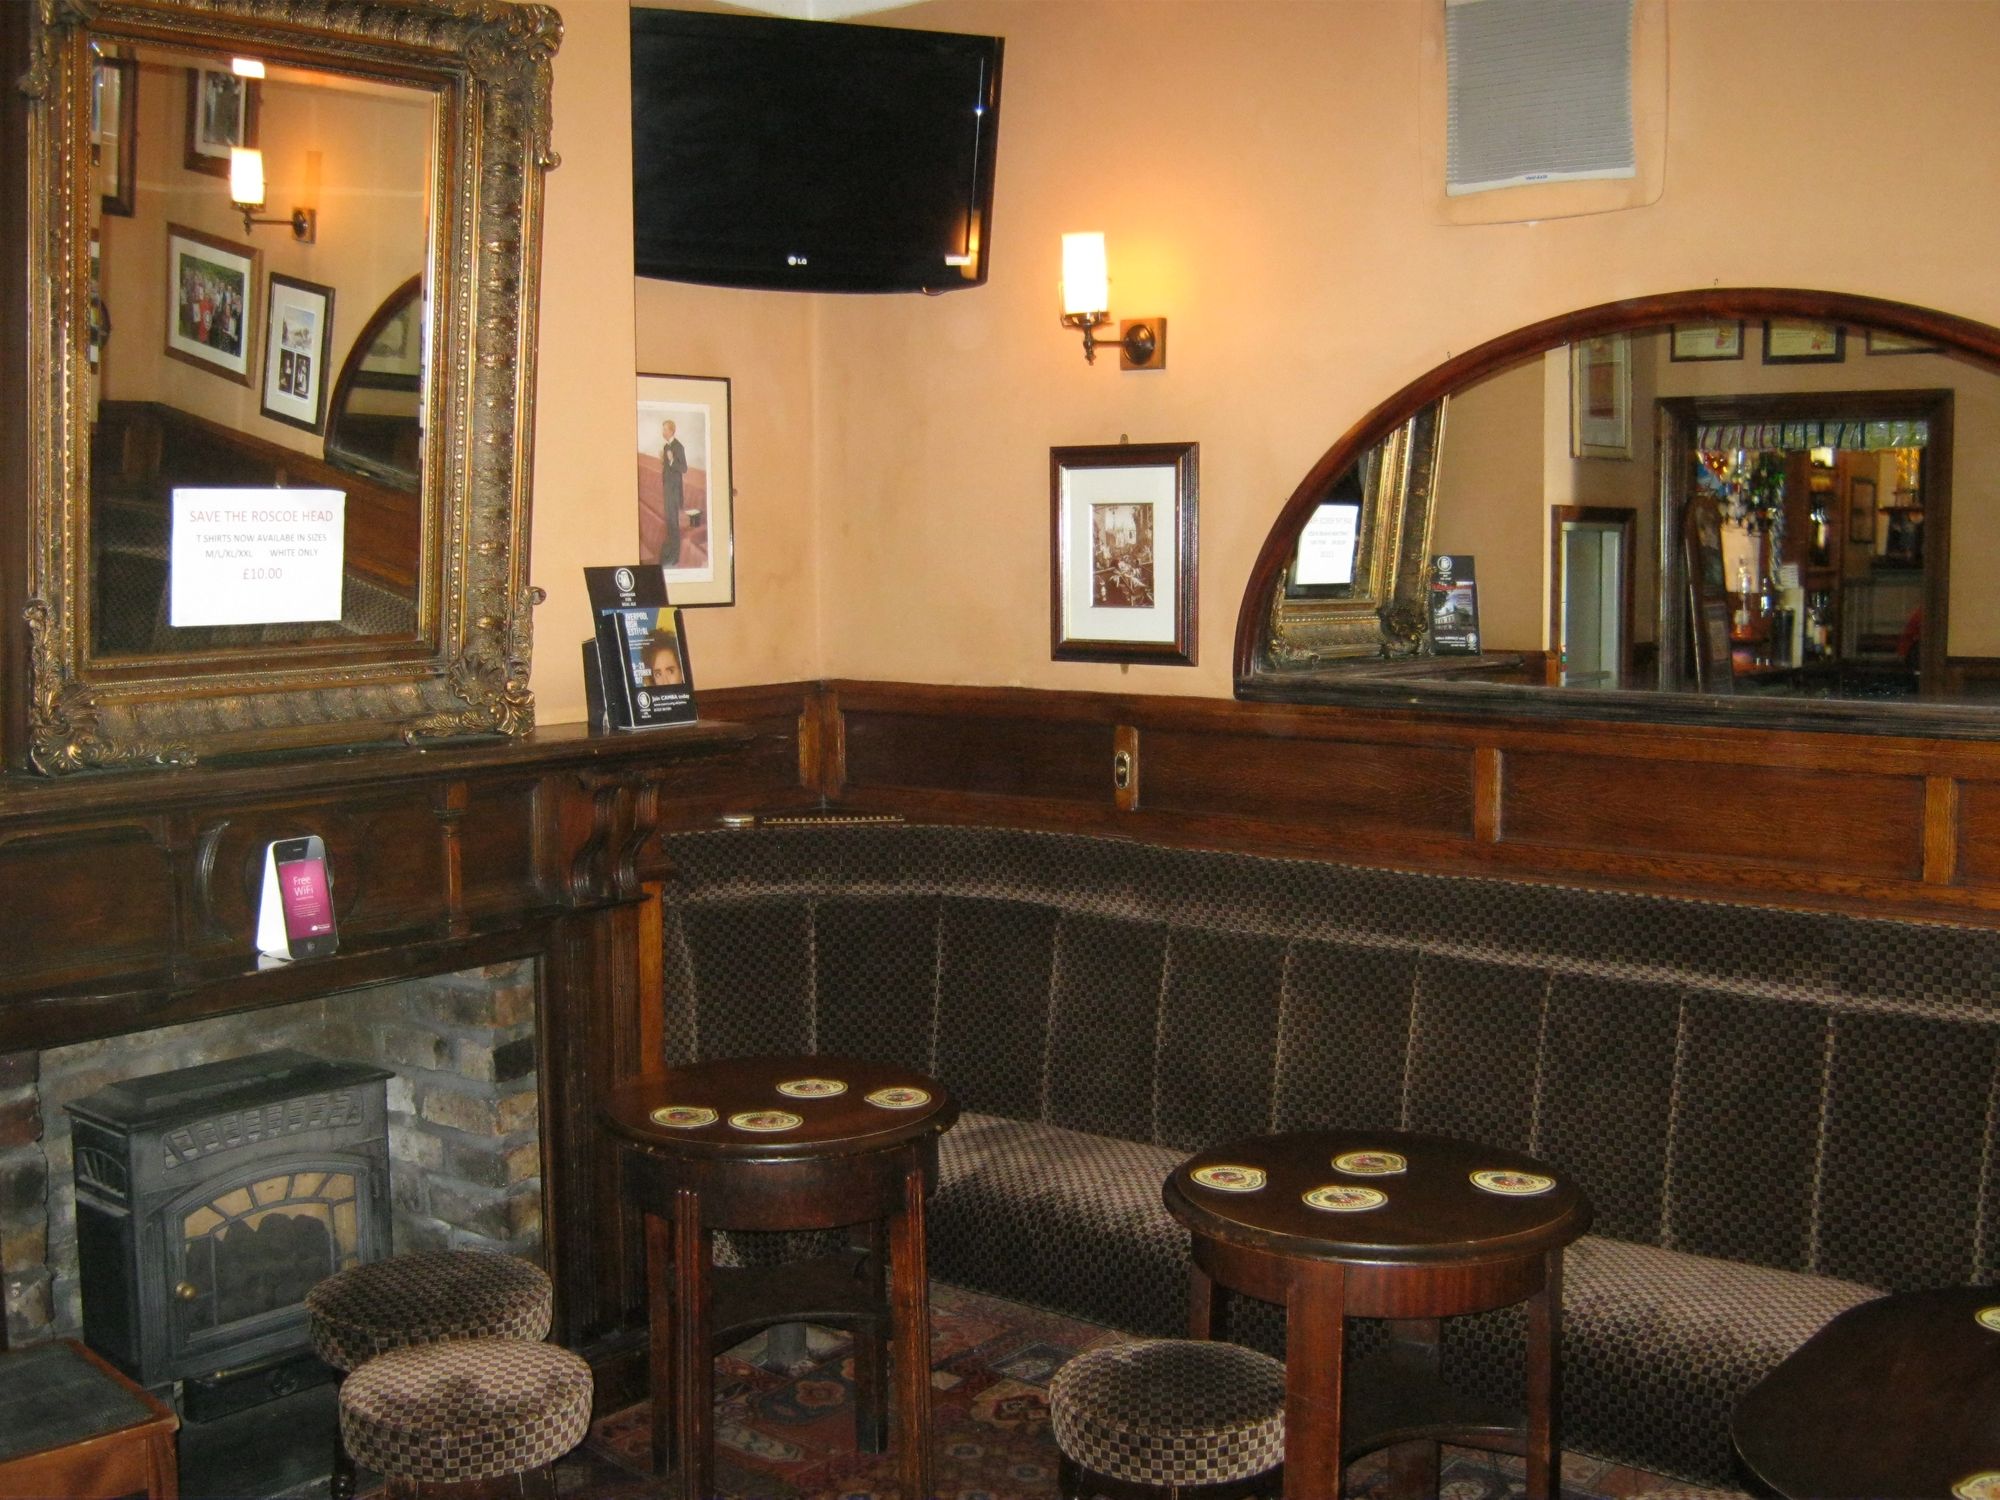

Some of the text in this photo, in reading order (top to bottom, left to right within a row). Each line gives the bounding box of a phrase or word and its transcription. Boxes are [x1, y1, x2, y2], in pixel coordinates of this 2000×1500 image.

[189, 510, 334, 523] SAVE THE ROSCOE HEAD
[203, 534, 232, 543] SHIRTS
[233, 534, 255, 543] NOW
[297, 533, 306, 541] IN
[307, 533, 327, 541] SIZES
[269, 548, 296, 558] WHITE
[298, 548, 319, 557] ONLY
[243, 567, 283, 580] £10.00
[293, 876, 312, 886] Free
